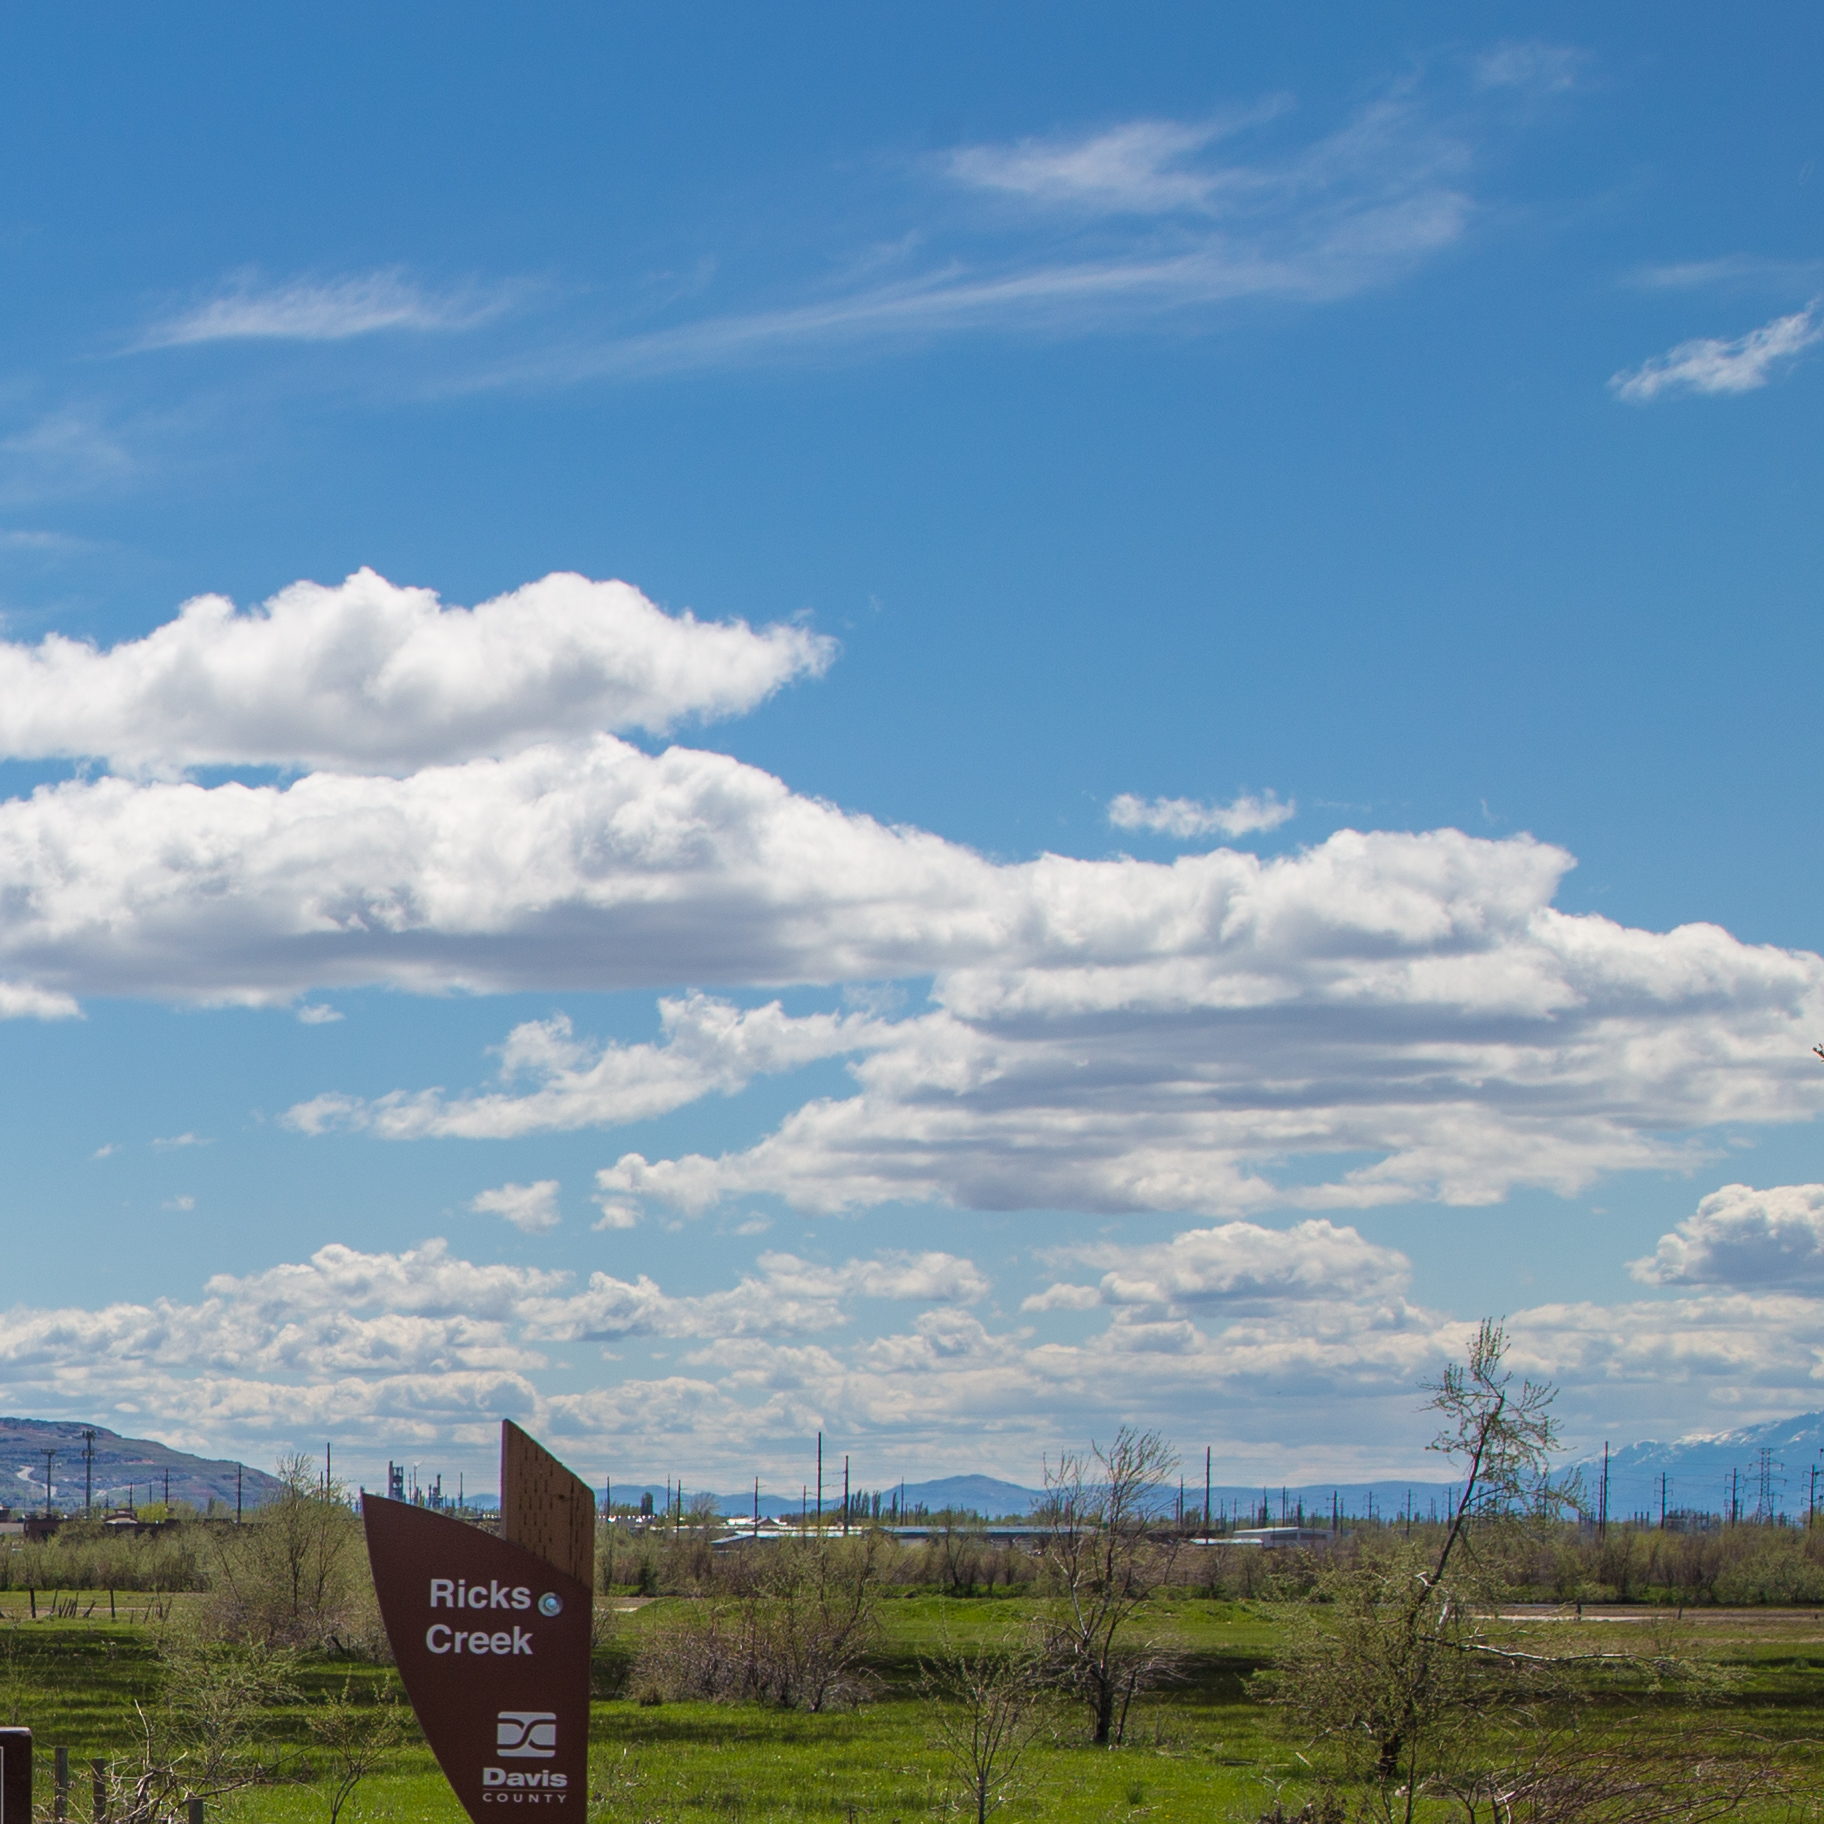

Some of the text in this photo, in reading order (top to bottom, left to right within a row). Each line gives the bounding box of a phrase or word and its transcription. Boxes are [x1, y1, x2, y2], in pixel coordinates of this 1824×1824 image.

[430, 1578, 532, 1610] Ricks
[426, 1624, 534, 1655] Creek
[482, 1767, 568, 1788] Davis
[482, 1793, 567, 1804] COUNTY
